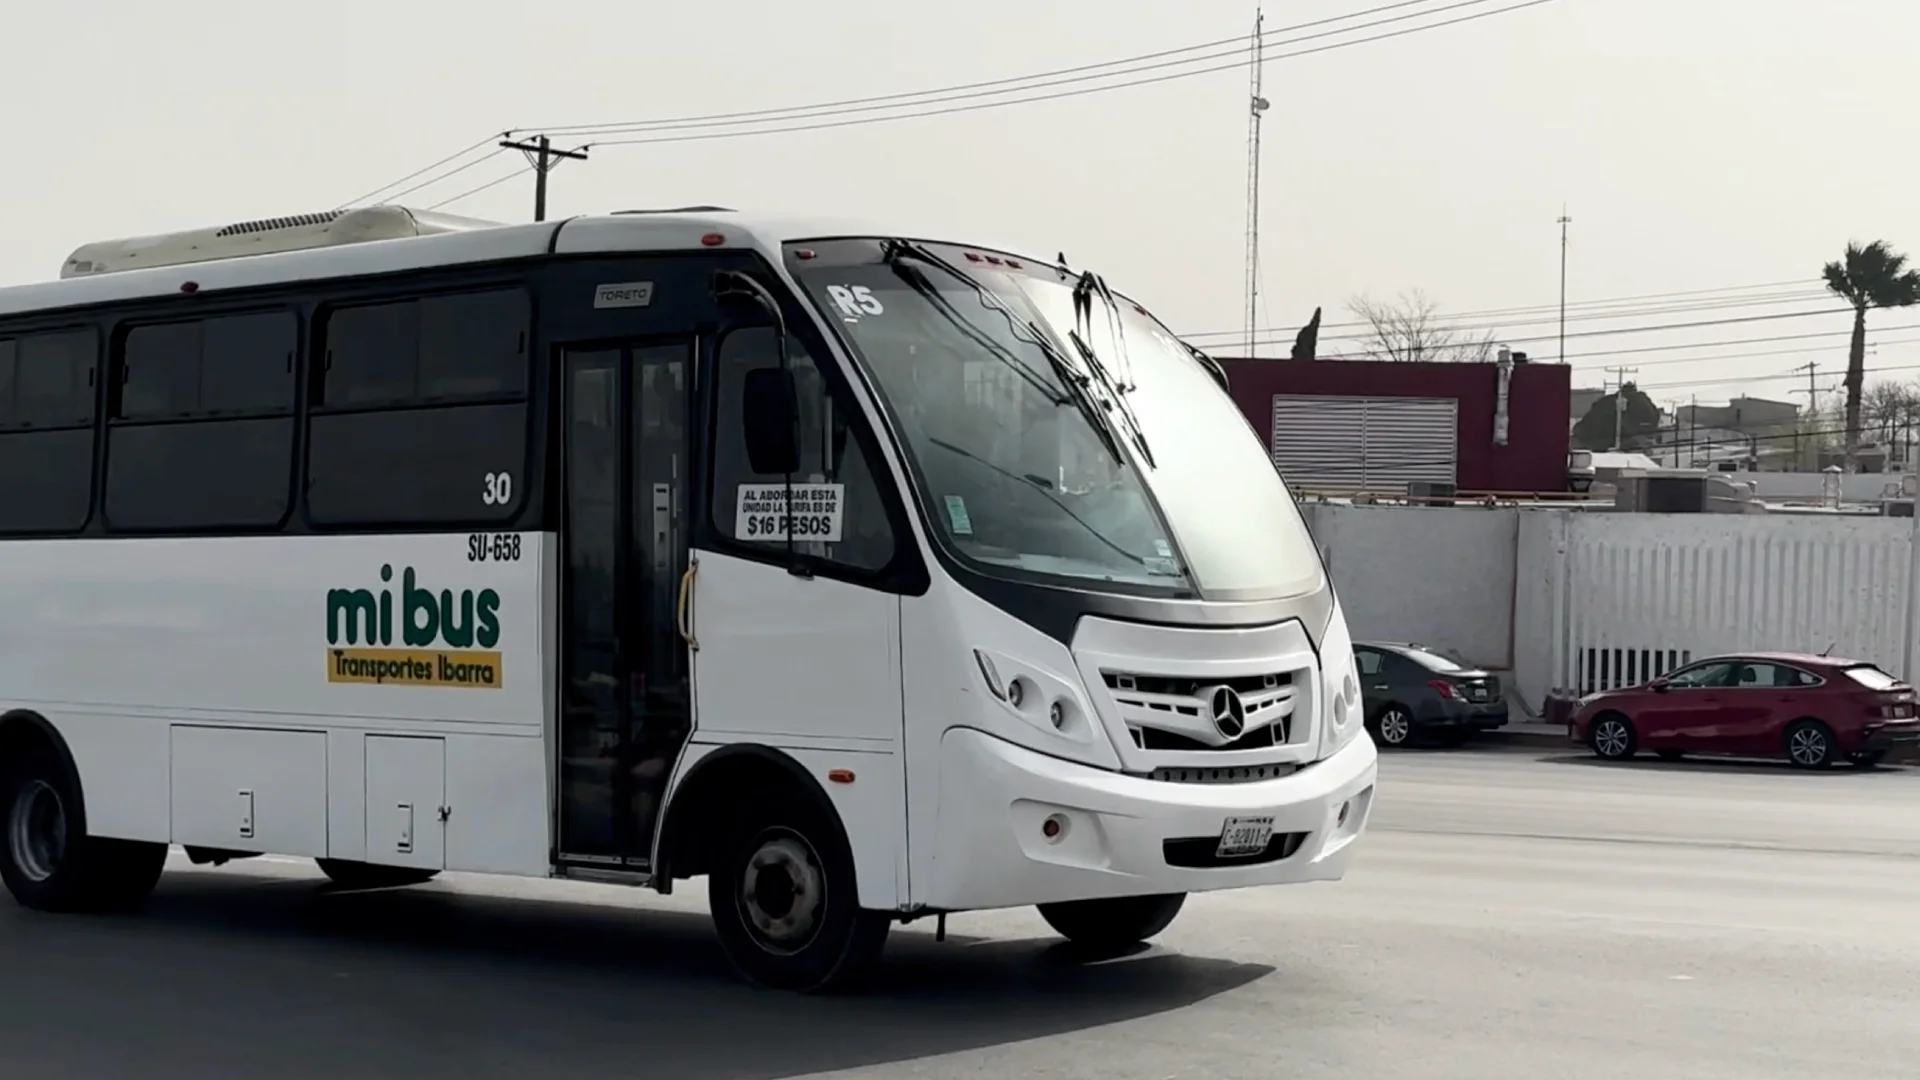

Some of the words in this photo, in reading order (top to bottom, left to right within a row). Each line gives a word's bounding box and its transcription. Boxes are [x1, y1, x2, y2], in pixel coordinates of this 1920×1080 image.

[601, 288, 647, 301] TORETO
[827, 285, 884, 317] R5
[483, 472, 511, 505] 30
[744, 490, 756, 500] AL
[811, 490, 837, 501] ESTA
[742, 502, 772, 513] UNIDAD
[773, 503, 783, 513] LA
[813, 502, 824, 513] ES
[825, 503, 837, 513] DE
[778, 515, 831, 535] PESOS
[468, 534, 521, 562] SU-658
[327, 563, 393, 646] mi
[403, 566, 501, 649] bus
[333, 650, 432, 684] Transportes
[438, 653, 494, 684] Ibarra
